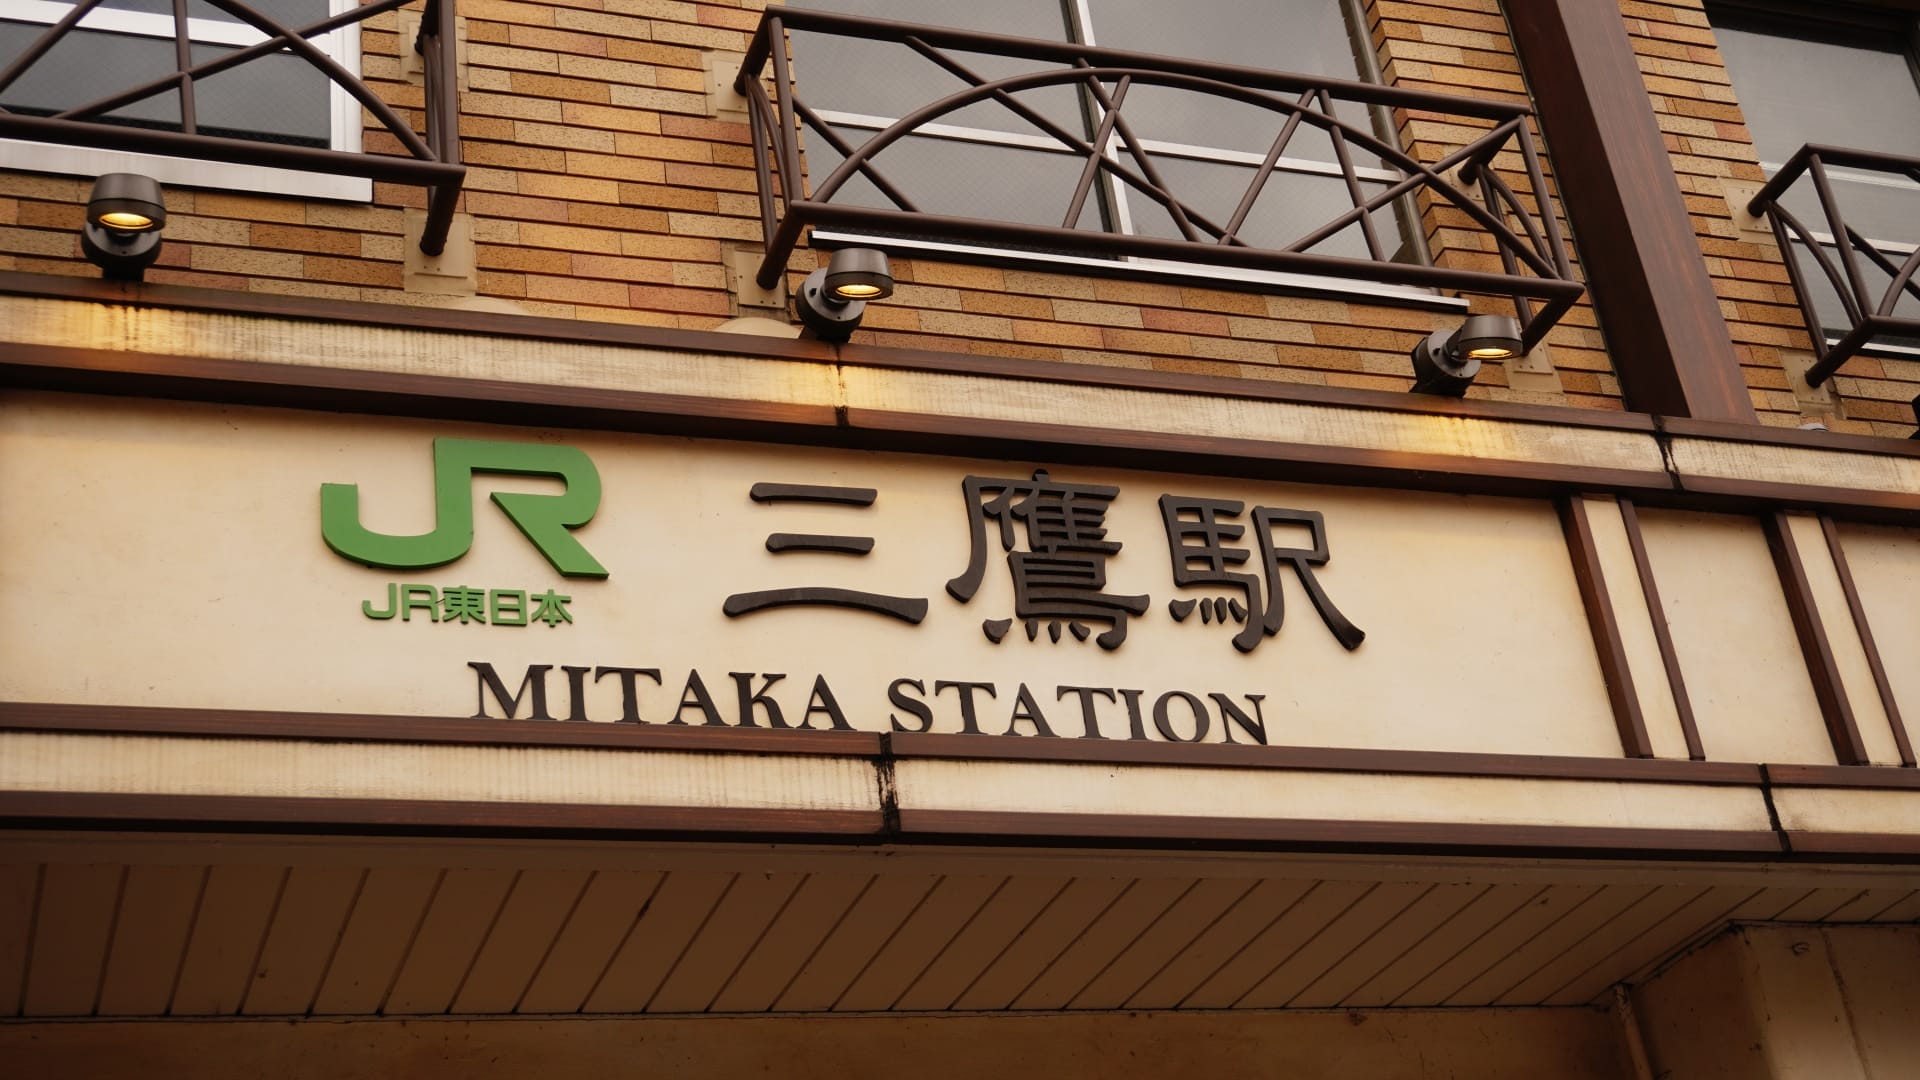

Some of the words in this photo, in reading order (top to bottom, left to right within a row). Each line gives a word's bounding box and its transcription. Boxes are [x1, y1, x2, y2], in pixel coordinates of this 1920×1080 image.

[320, 437, 609, 579] JR
[722, 469, 1366, 653] 三鷹駅
[362, 582, 573, 627] JR東日本
[467, 661, 857, 731] MITAKA
[887, 678, 1268, 745] STATION
